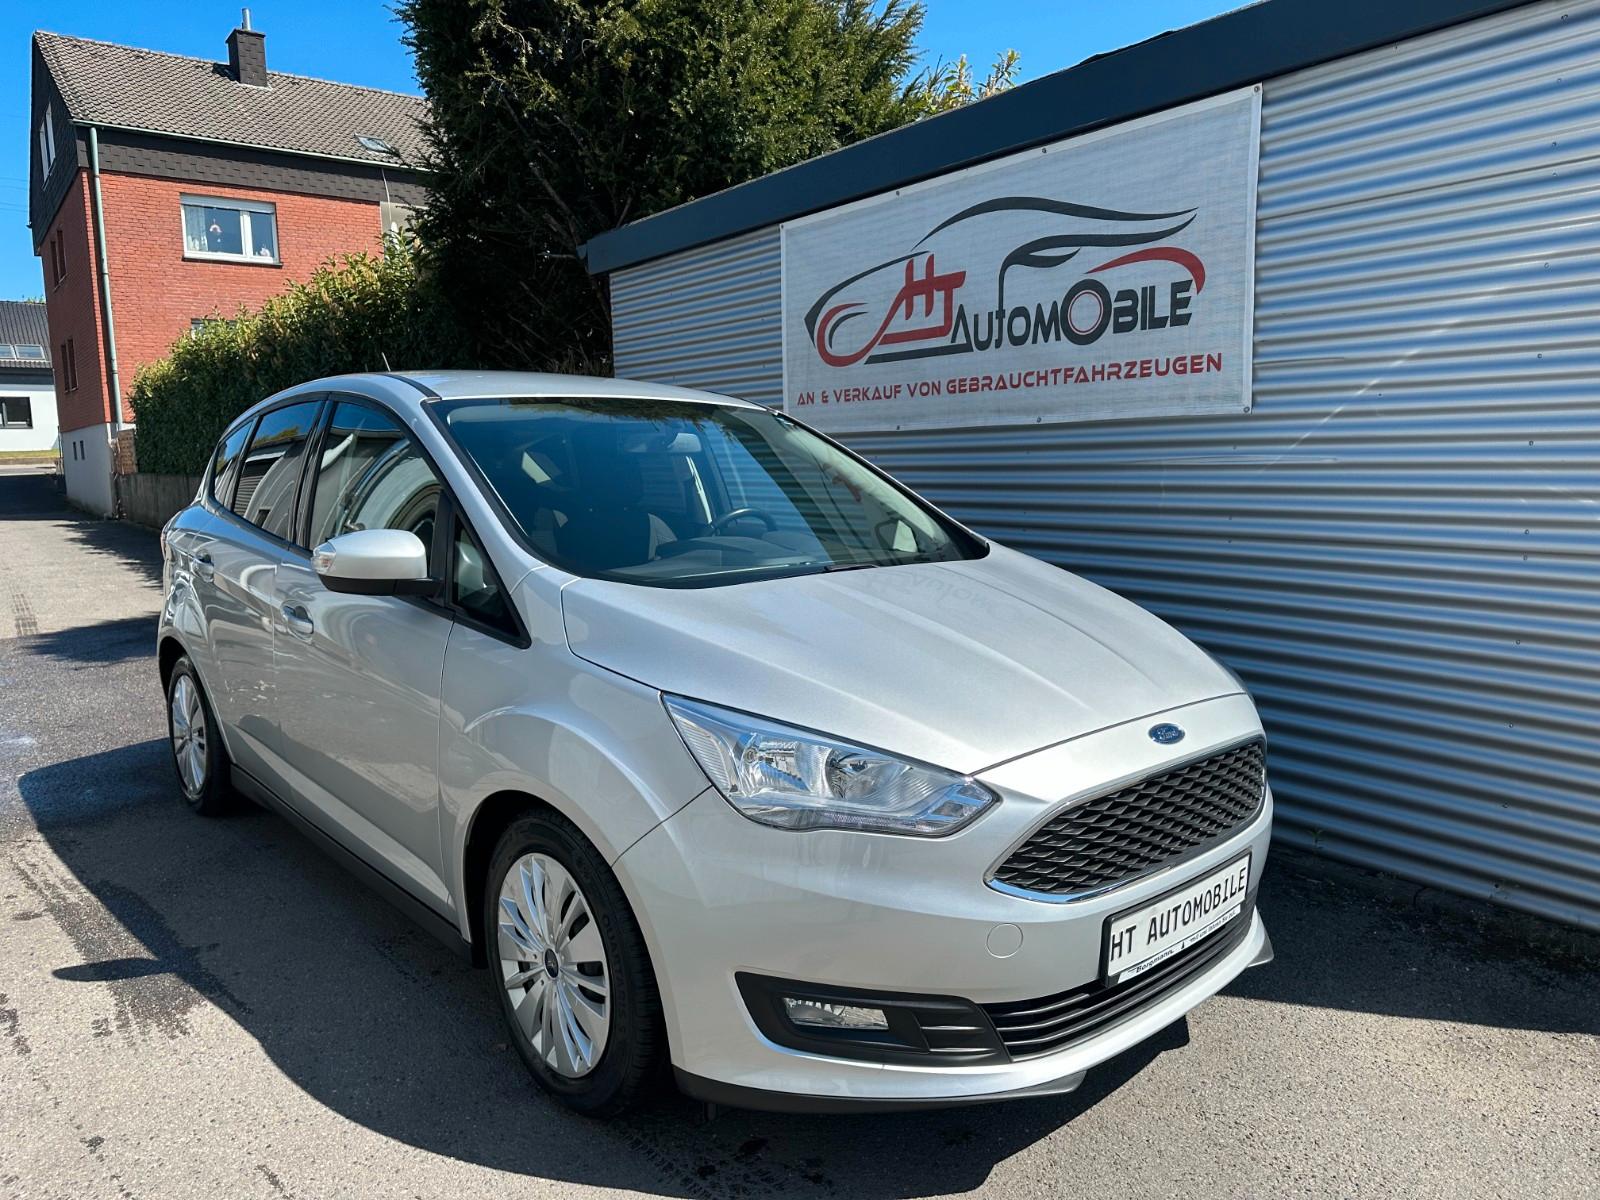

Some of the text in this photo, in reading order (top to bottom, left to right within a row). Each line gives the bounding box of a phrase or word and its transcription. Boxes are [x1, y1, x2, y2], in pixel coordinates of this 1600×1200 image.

[951, 278, 1193, 352] AUTOMOBILE
[797, 353, 1222, 406] AN & VERKAUF VON GEBRAUCHTFAHRZEUGEN
[1110, 925, 1137, 963] HT
[1146, 866, 1247, 946] AUTOMOBILE
